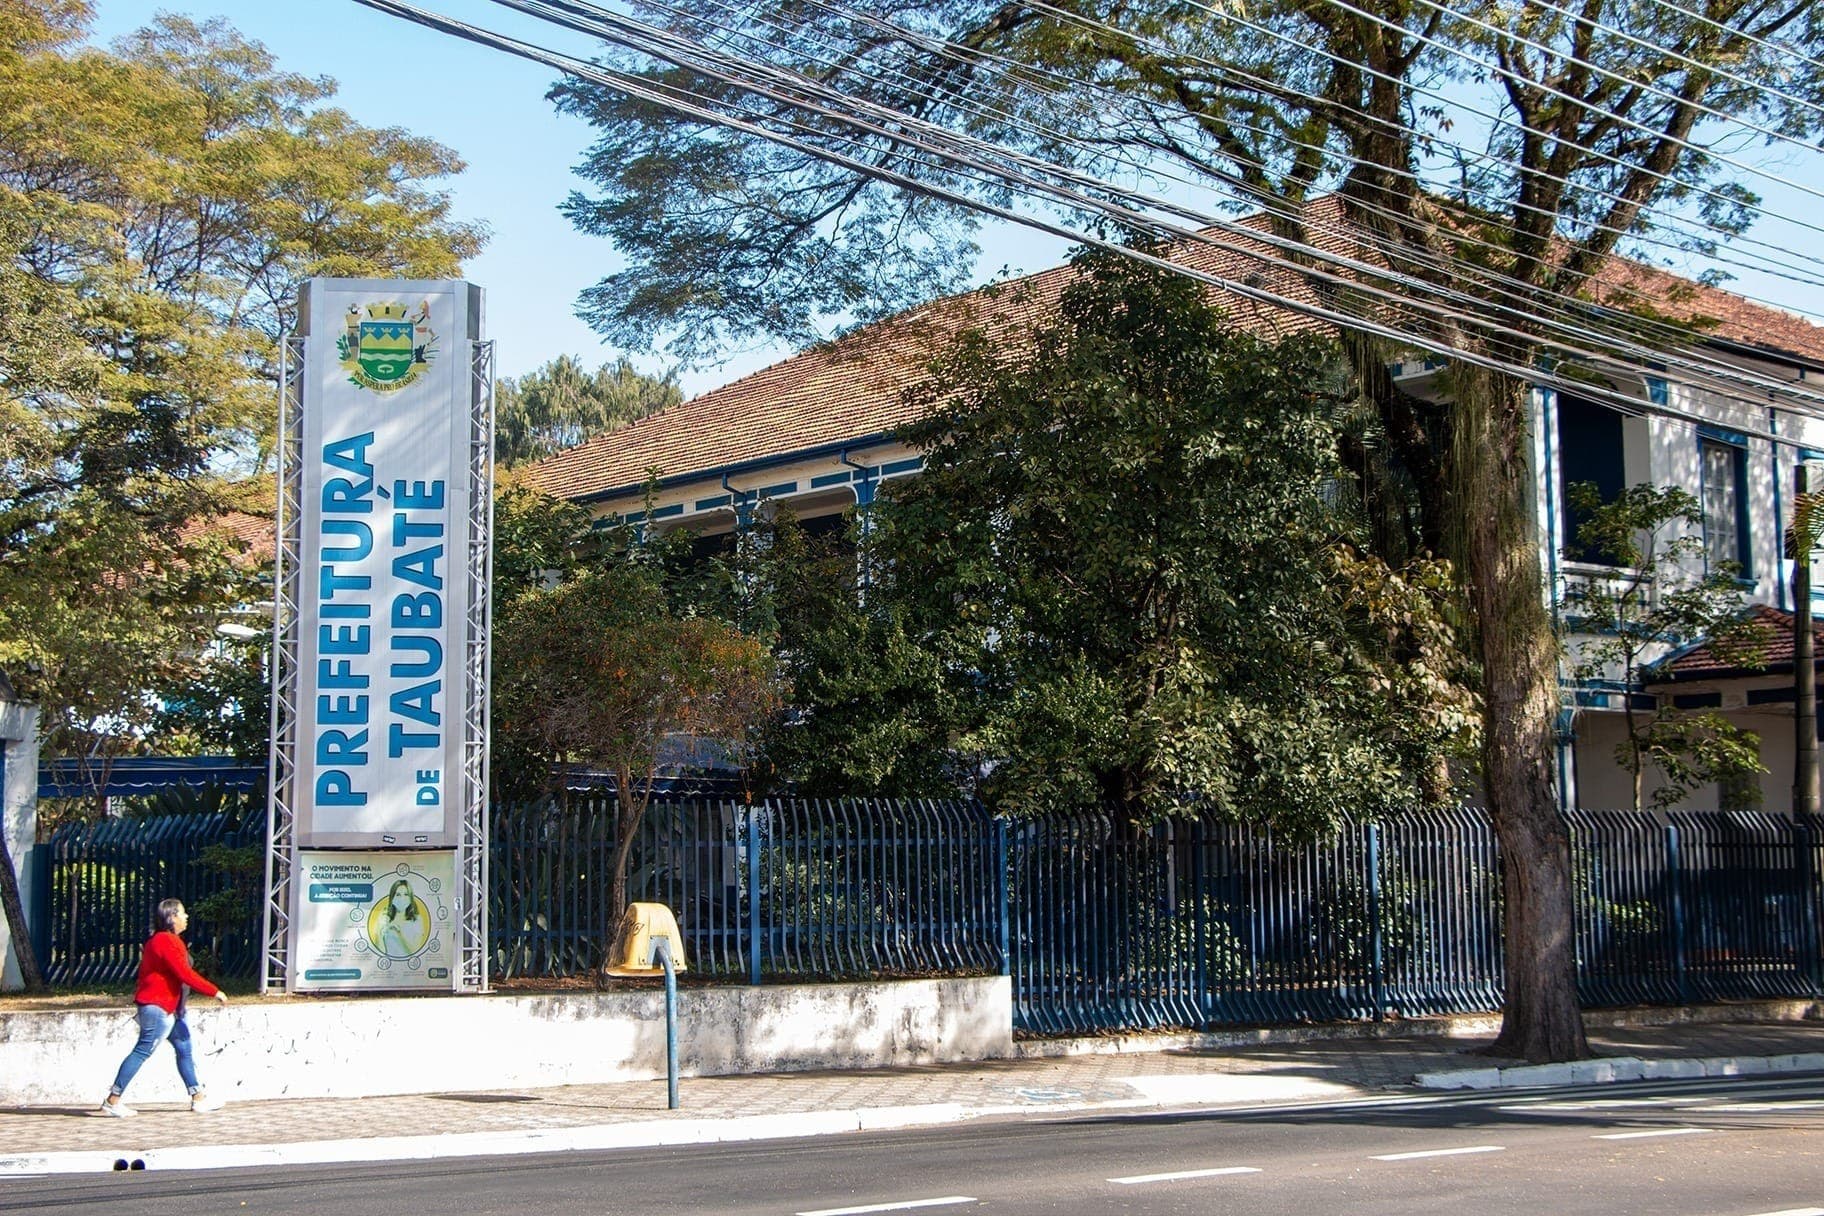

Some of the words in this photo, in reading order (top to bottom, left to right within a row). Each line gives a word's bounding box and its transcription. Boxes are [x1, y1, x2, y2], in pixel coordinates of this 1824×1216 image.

[315, 431, 375, 806] PREFEITURA
[377, 480, 445, 758] TAUBATÉ
[416, 769, 440, 806] DE
